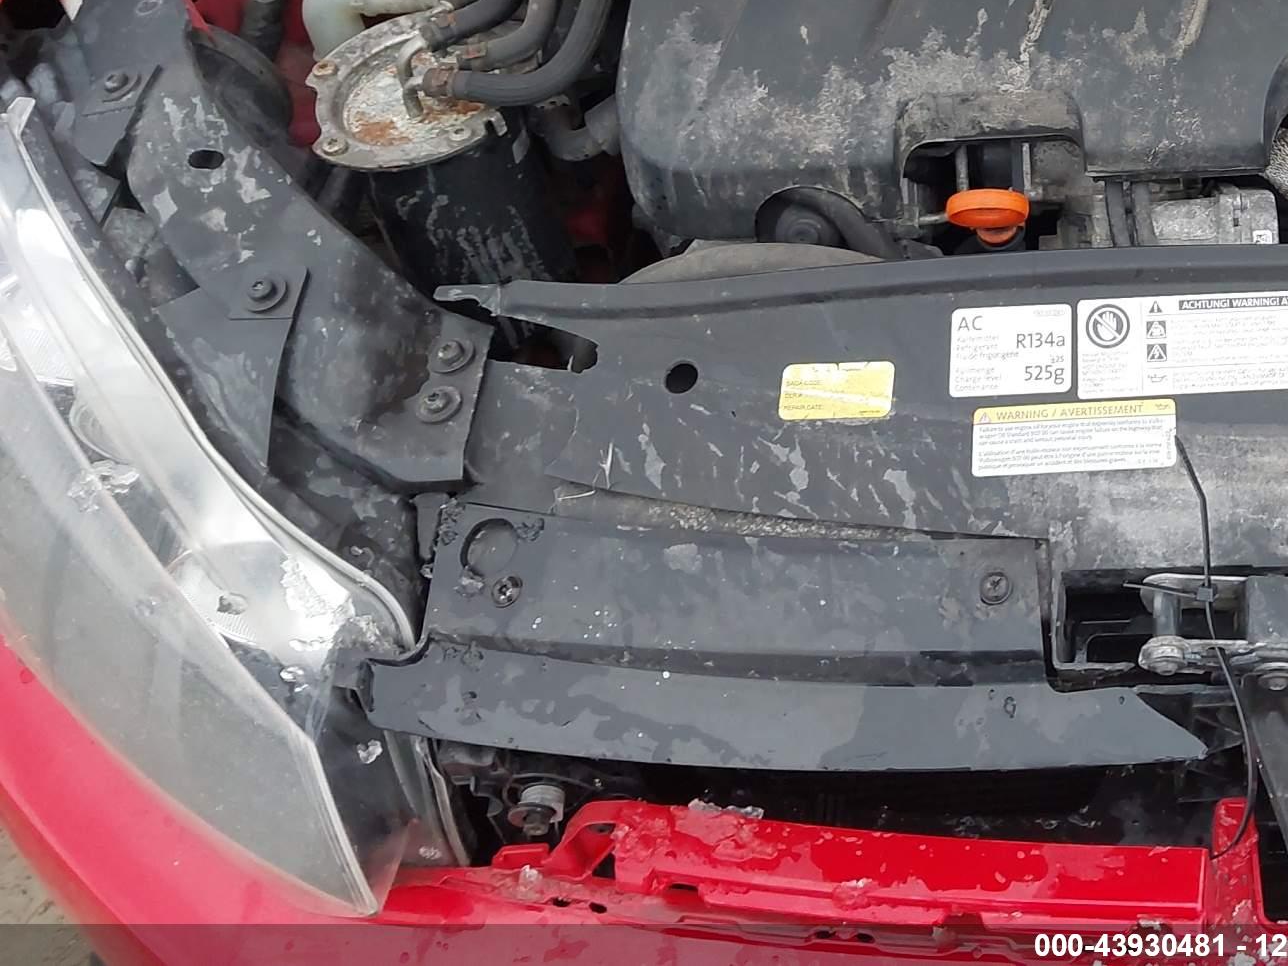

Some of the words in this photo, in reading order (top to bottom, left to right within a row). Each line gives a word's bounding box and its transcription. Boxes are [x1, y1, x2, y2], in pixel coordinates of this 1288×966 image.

[1182, 299, 1230, 310] ACHTUNG!
[1232, 297, 1280, 307] WARNING!
[958, 315, 982, 331] AC
[1016, 332, 1065, 349] R134a
[1024, 364, 1065, 385] 525g
[996, 409, 1049, 420] WARNING
[1060, 405, 1143, 418] AVERTISSEMENT
